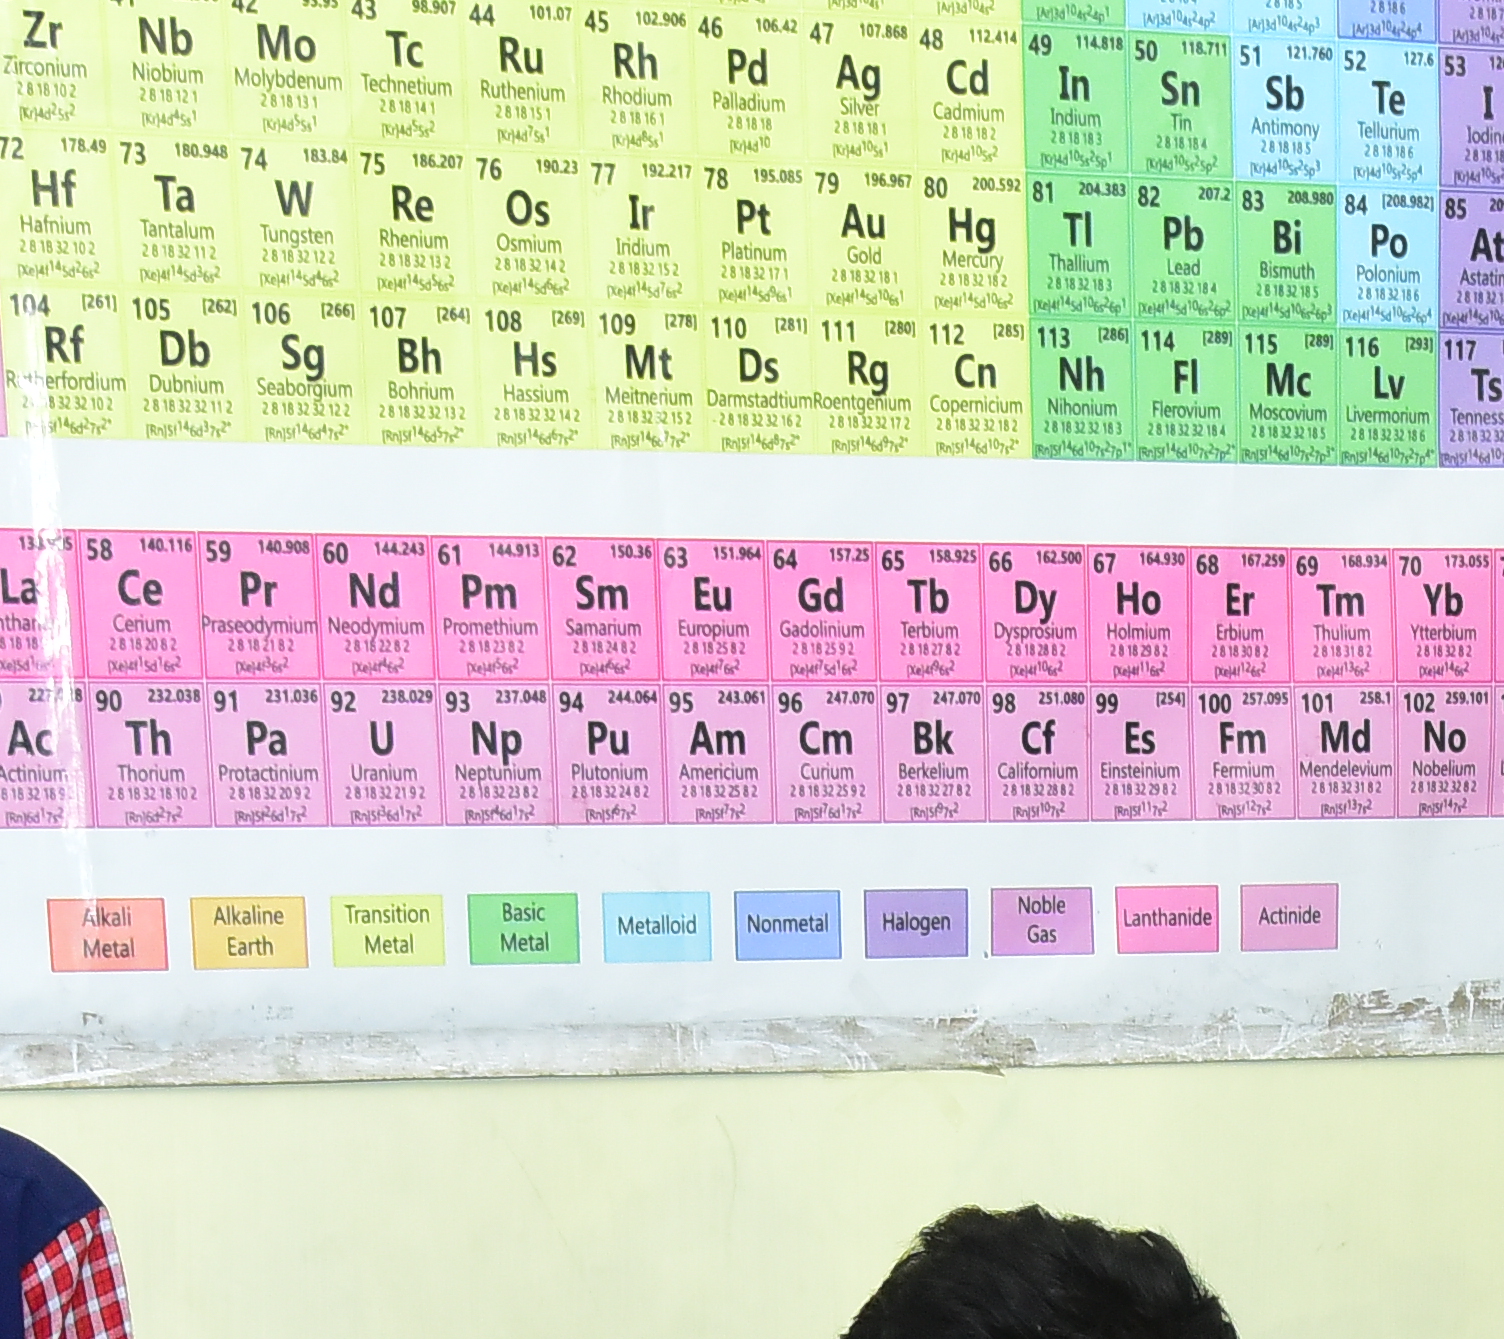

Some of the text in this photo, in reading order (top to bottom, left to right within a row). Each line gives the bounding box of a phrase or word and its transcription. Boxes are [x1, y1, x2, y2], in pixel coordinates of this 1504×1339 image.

[22, 9, 64, 50] Zr
[138, 16, 194, 57] Nb
[384, 29, 424, 69] Tc
[613, 41, 659, 81] Rh
[480, 78, 566, 102] Ruthenium
[712, 91, 786, 113] Palladium
[1058, 64, 1091, 103] In
[1265, 73, 1305, 112] Sb
[1357, 120, 1420, 141] Tellurium
[30, 168, 77, 208] Hf
[153, 174, 196, 214] Ta
[274, 179, 314, 218] W
[391, 184, 435, 223] Re
[505, 189, 551, 228] Os
[628, 193, 656, 231] Ir
[736, 198, 772, 237] Pt
[840, 202, 886, 240] Au
[139, 218, 215, 240] Tantalum
[1062, 210, 1093, 248] Tl
[1163, 214, 1205, 253] Pb
[1273, 218, 1302, 256] Bi
[1371, 223, 1409, 260] Po
[847, 245, 882, 265] Gold
[1167, 258, 1201, 277] Lead
[397, 335, 443, 375] Bh
[513, 340, 558, 378] Hs
[1058, 354, 1105, 393] Nh
[1373, 365, 1406, 401] Lv
[117, 568, 164, 607] Ce
[239, 570, 278, 608] Pr
[461, 573, 518, 610] Pm
[693, 575, 733, 613] Eu
[906, 576, 950, 615] Tb
[1225, 582, 1256, 617] Er
[443, 617, 539, 636] Promethium
[1106, 622, 1171, 641] Holmium
[124, 717, 172, 757] Th
[245, 719, 288, 757] Pa
[369, 720, 395, 757] U
[587, 720, 630, 757] Pu
[1021, 718, 1057, 756] Cf
[1423, 719, 1467, 754] No
[350, 762, 418, 782] Uranium
[1212, 760, 1275, 779] Fermium
[82, 905, 132, 928] Alkali
[213, 904, 285, 926] Alkaline
[344, 903, 430, 925] Transition
[502, 901, 546, 923] Basic
[1017, 893, 1066, 915] Noble
[1123, 906, 1212, 929] Lanthanide
[1258, 904, 1322, 926] Actinide
[500, 930, 550, 953] Metal
[617, 913, 697, 936] Metalloid
[747, 912, 829, 934] Nonmetal
[882, 910, 951, 937] Halogen
[1026, 923, 1058, 944] Gas
[83, 937, 135, 959] Metal
[226, 934, 274, 957] Earth
[364, 932, 414, 955] Metal
